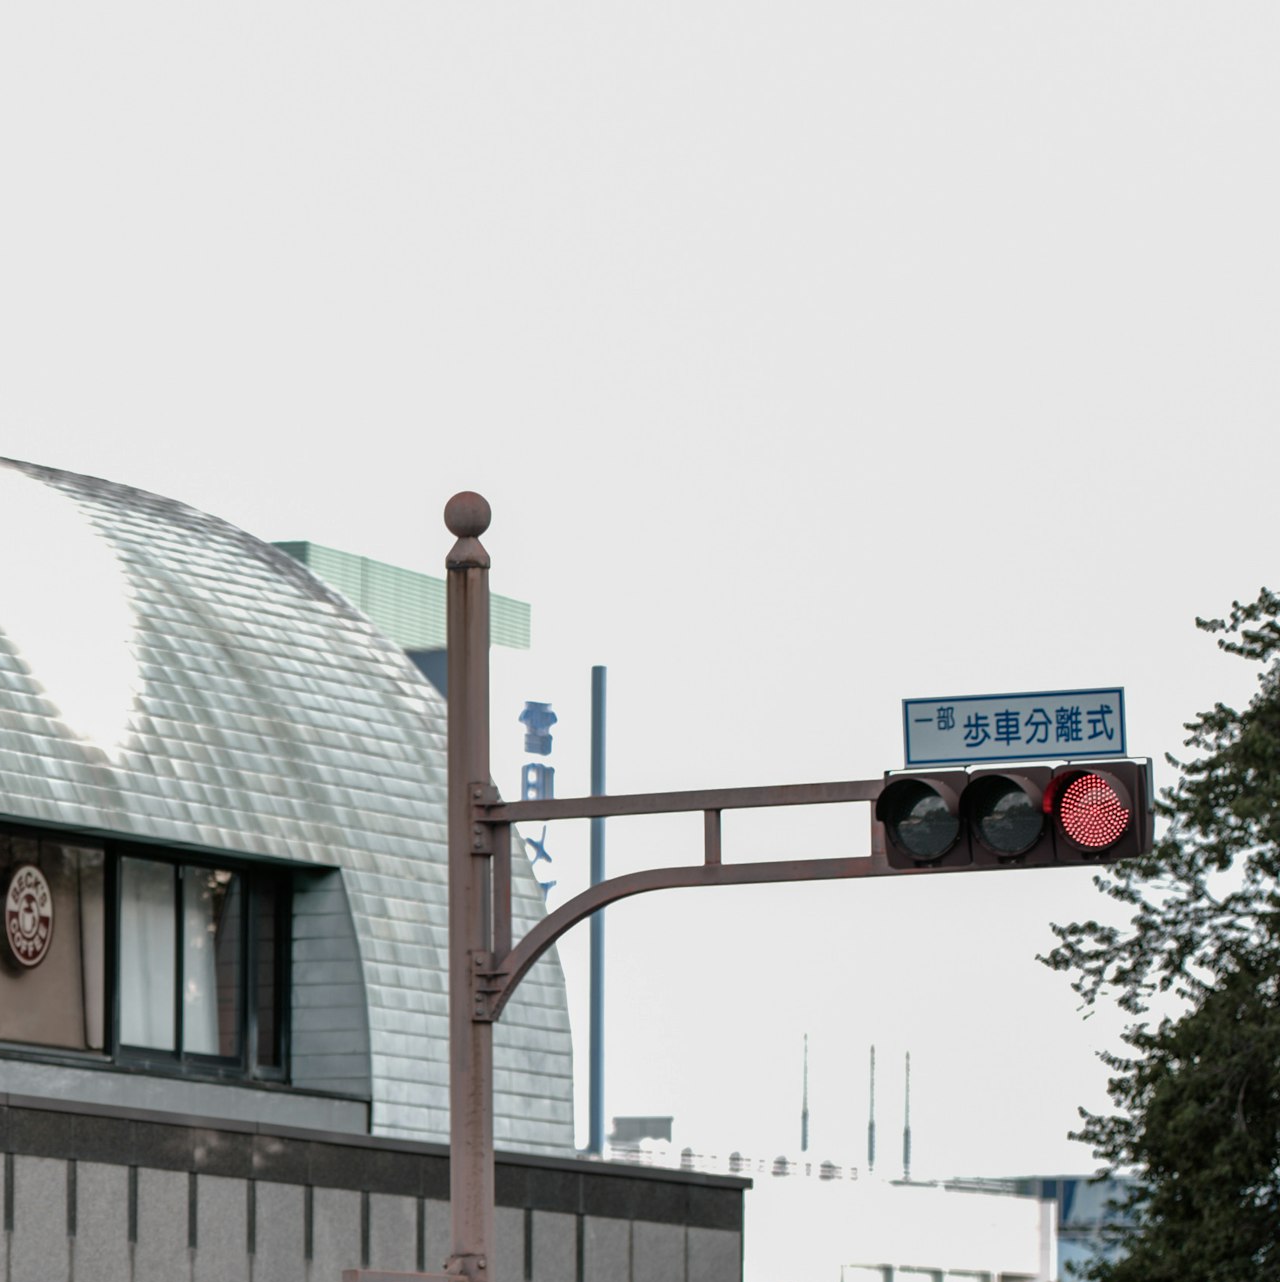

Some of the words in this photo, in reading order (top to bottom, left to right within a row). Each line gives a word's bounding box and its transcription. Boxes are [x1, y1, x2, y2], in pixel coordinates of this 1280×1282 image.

[914, 706, 956, 730] 一部
[963, 704, 1115, 748] 歩車分離式
[10, 918, 48, 957] COFFEE
